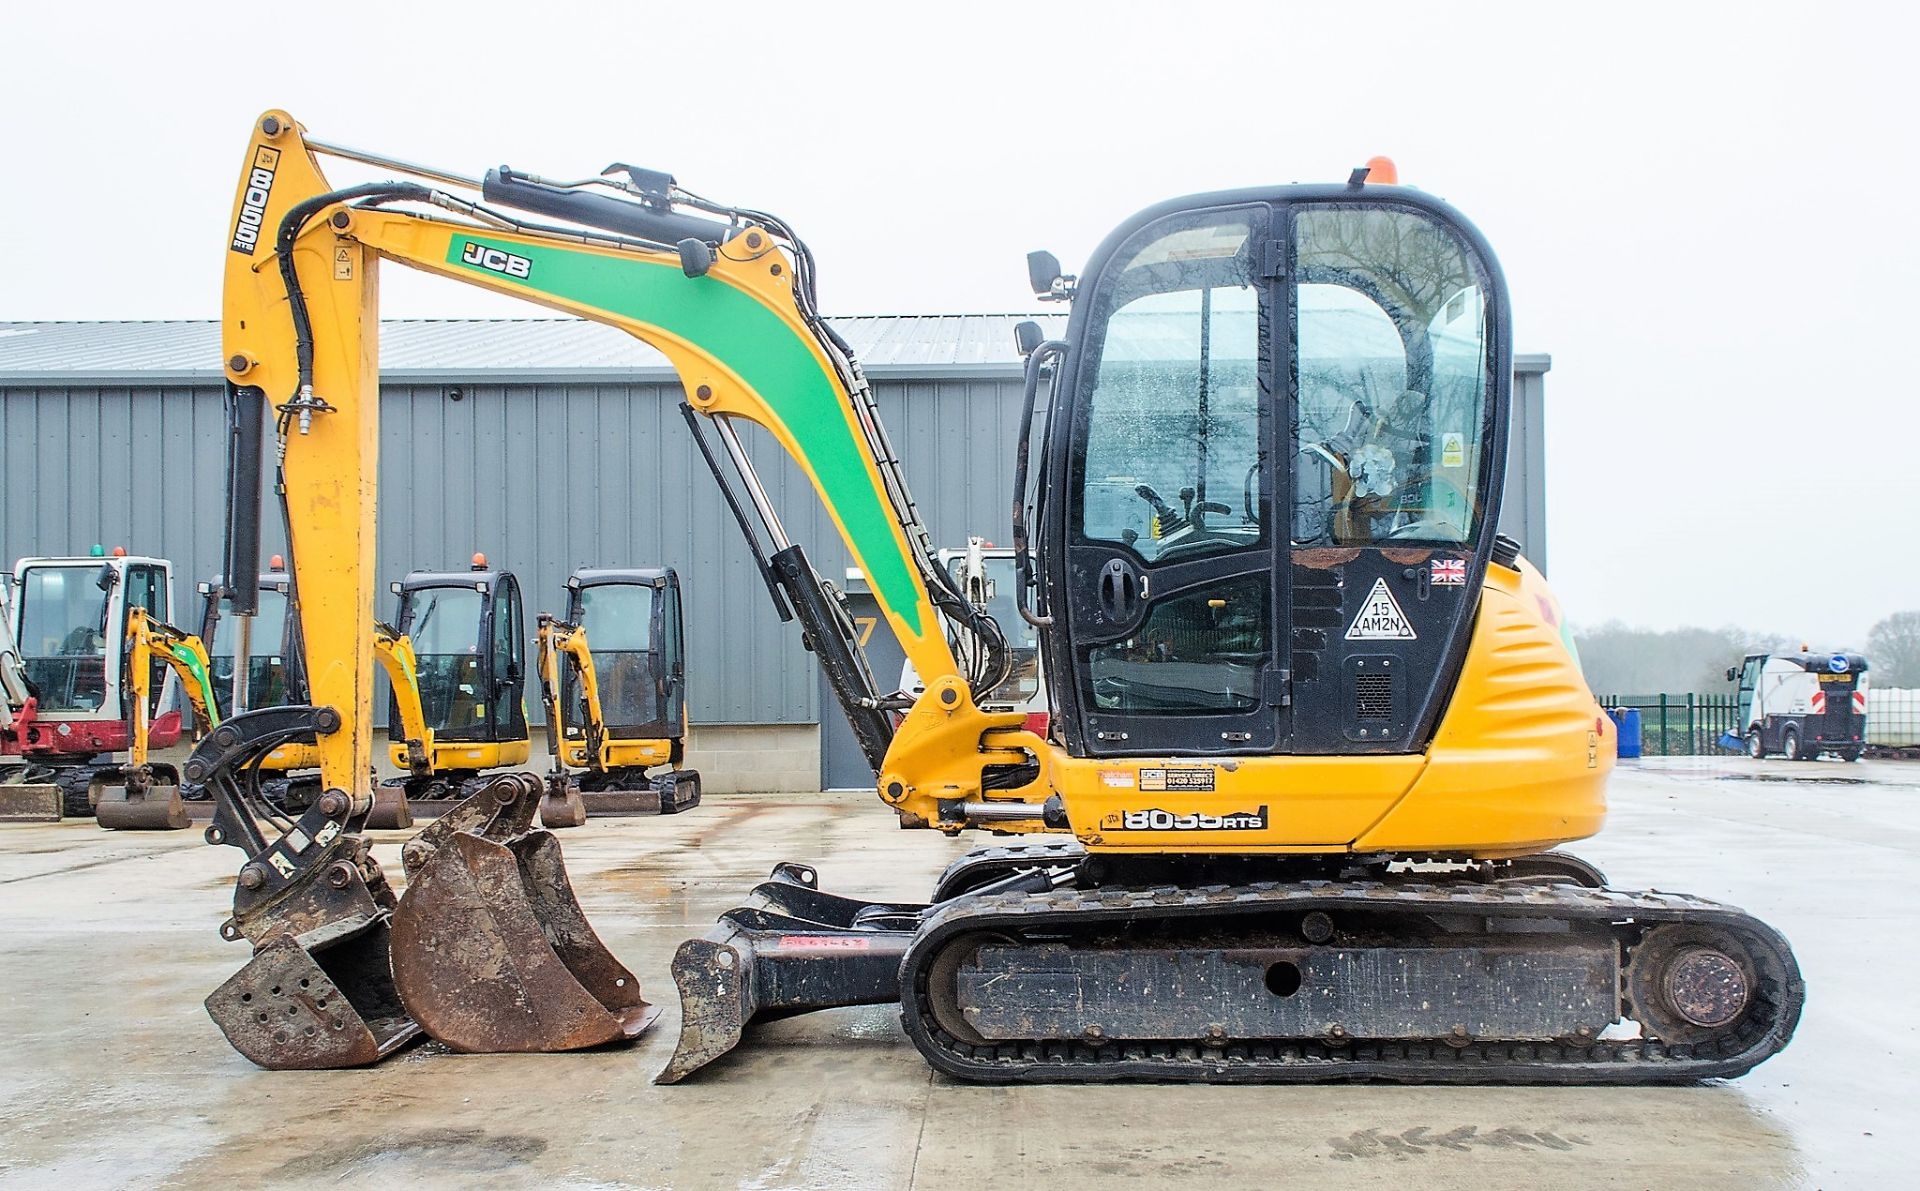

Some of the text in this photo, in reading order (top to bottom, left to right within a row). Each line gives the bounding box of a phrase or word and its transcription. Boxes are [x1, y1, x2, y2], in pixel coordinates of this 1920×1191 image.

[463, 242, 531, 278] JCB
[1372, 602, 1390, 616] 15
[854, 617, 877, 647] 7
[1362, 617, 1400, 631] AM2N
